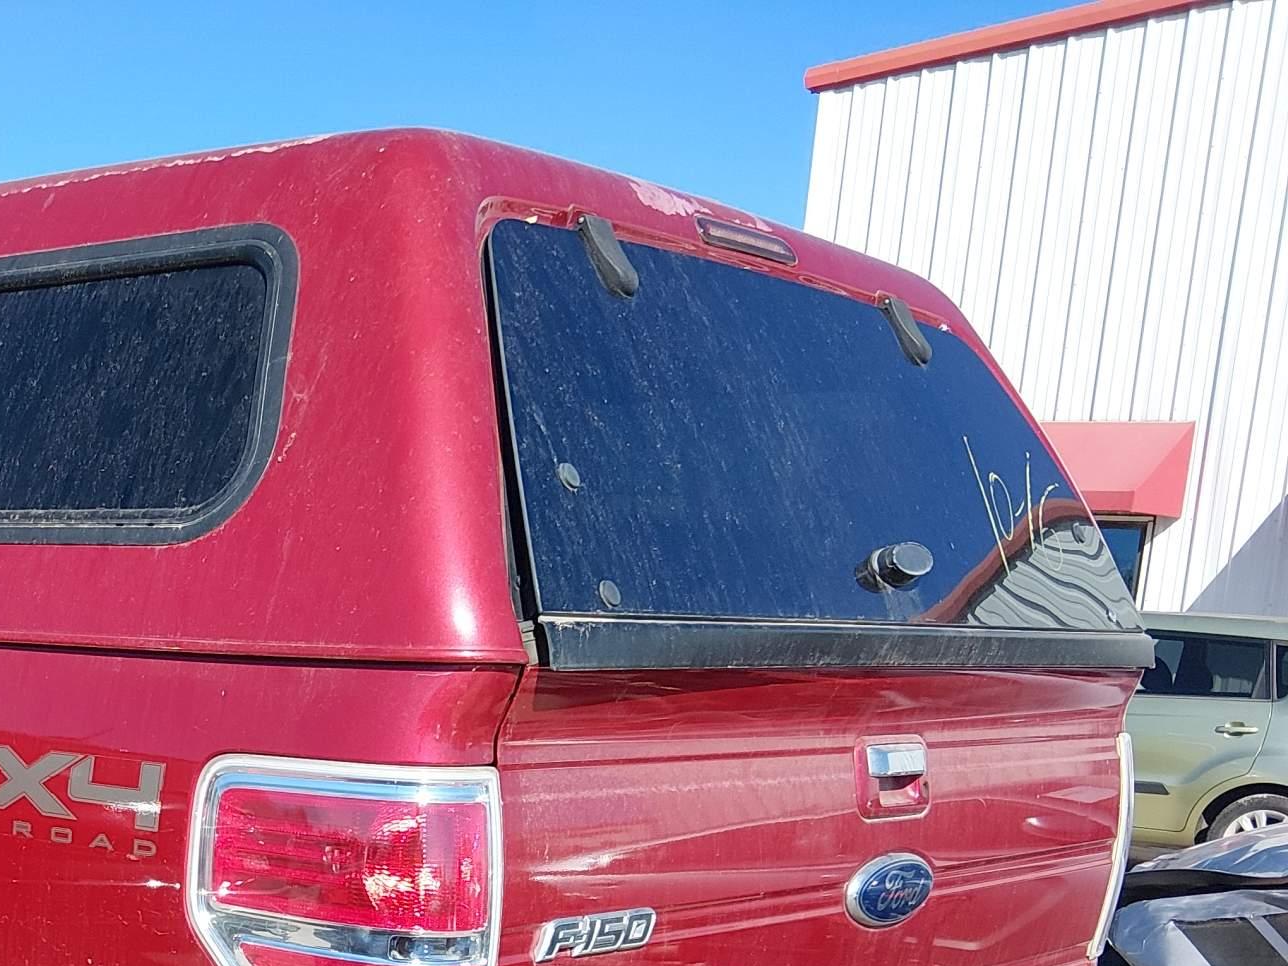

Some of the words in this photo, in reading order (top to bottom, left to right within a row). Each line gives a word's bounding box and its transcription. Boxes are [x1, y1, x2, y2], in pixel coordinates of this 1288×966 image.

[12, 820, 158, 858] ROAD
[876, 870, 922, 912] Ford
[535, 907, 656, 963] F-150
